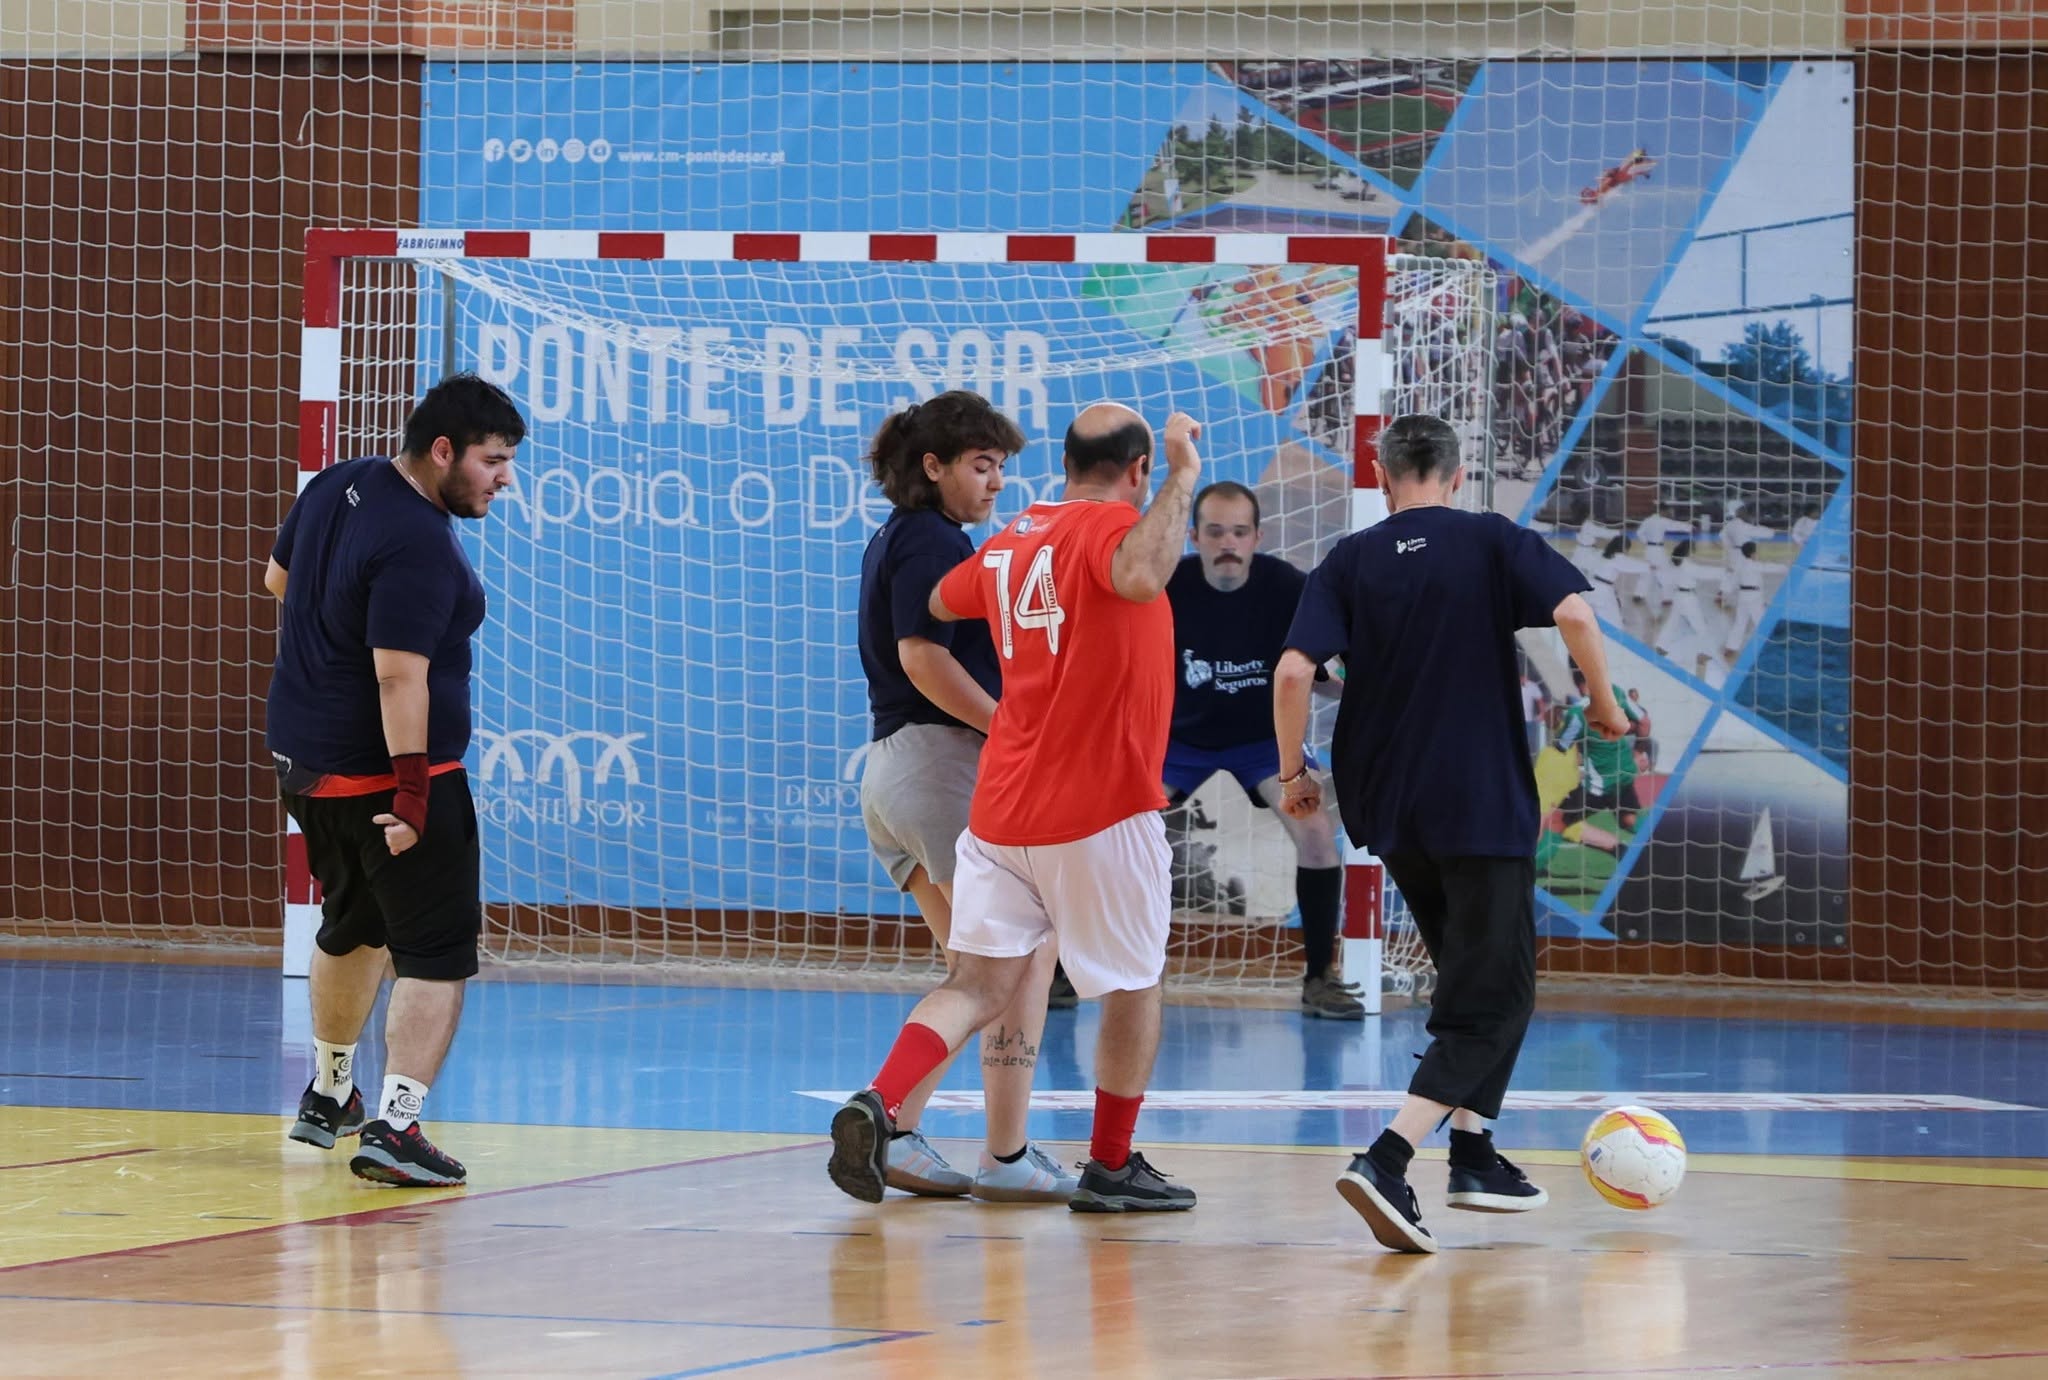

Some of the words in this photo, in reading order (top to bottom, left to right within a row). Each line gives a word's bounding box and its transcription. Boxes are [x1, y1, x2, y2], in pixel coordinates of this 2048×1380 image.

[396, 238, 465, 249] FABRIGIMNO
[478, 324, 731, 424] PONTE
[764, 327, 862, 426] DE
[892, 328, 1049, 429] SOR
[729, 470, 776, 527] o
[983, 545, 1066, 660] 14
[1215, 660, 1264, 673] Liberty
[1215, 677, 1268, 694] Seguros
